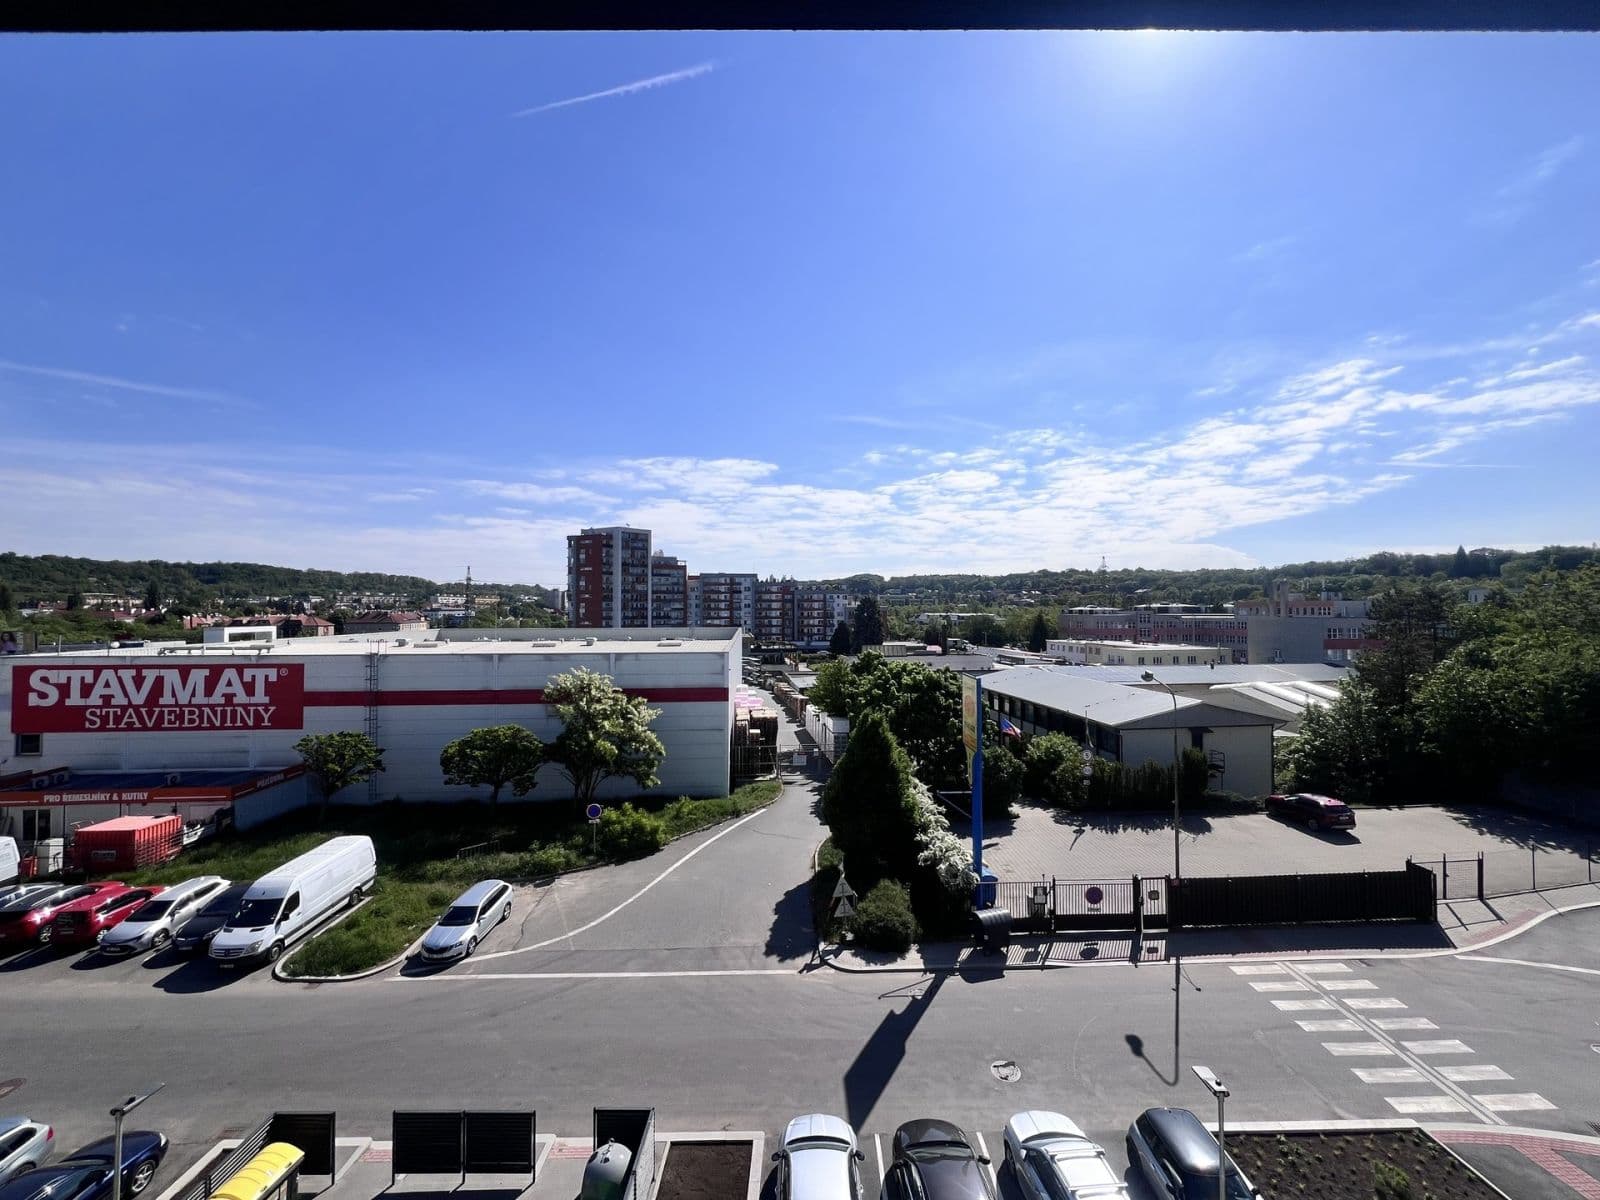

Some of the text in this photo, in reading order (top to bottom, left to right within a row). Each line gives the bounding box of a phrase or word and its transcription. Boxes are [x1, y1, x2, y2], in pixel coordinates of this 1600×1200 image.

[28, 668, 278, 707] STAVMAT
[85, 706, 277, 729] STAVEBNINY
[44, 794, 61, 802] PRO
[112, 793, 119, 801] &
[121, 792, 148, 801] KUTILY
